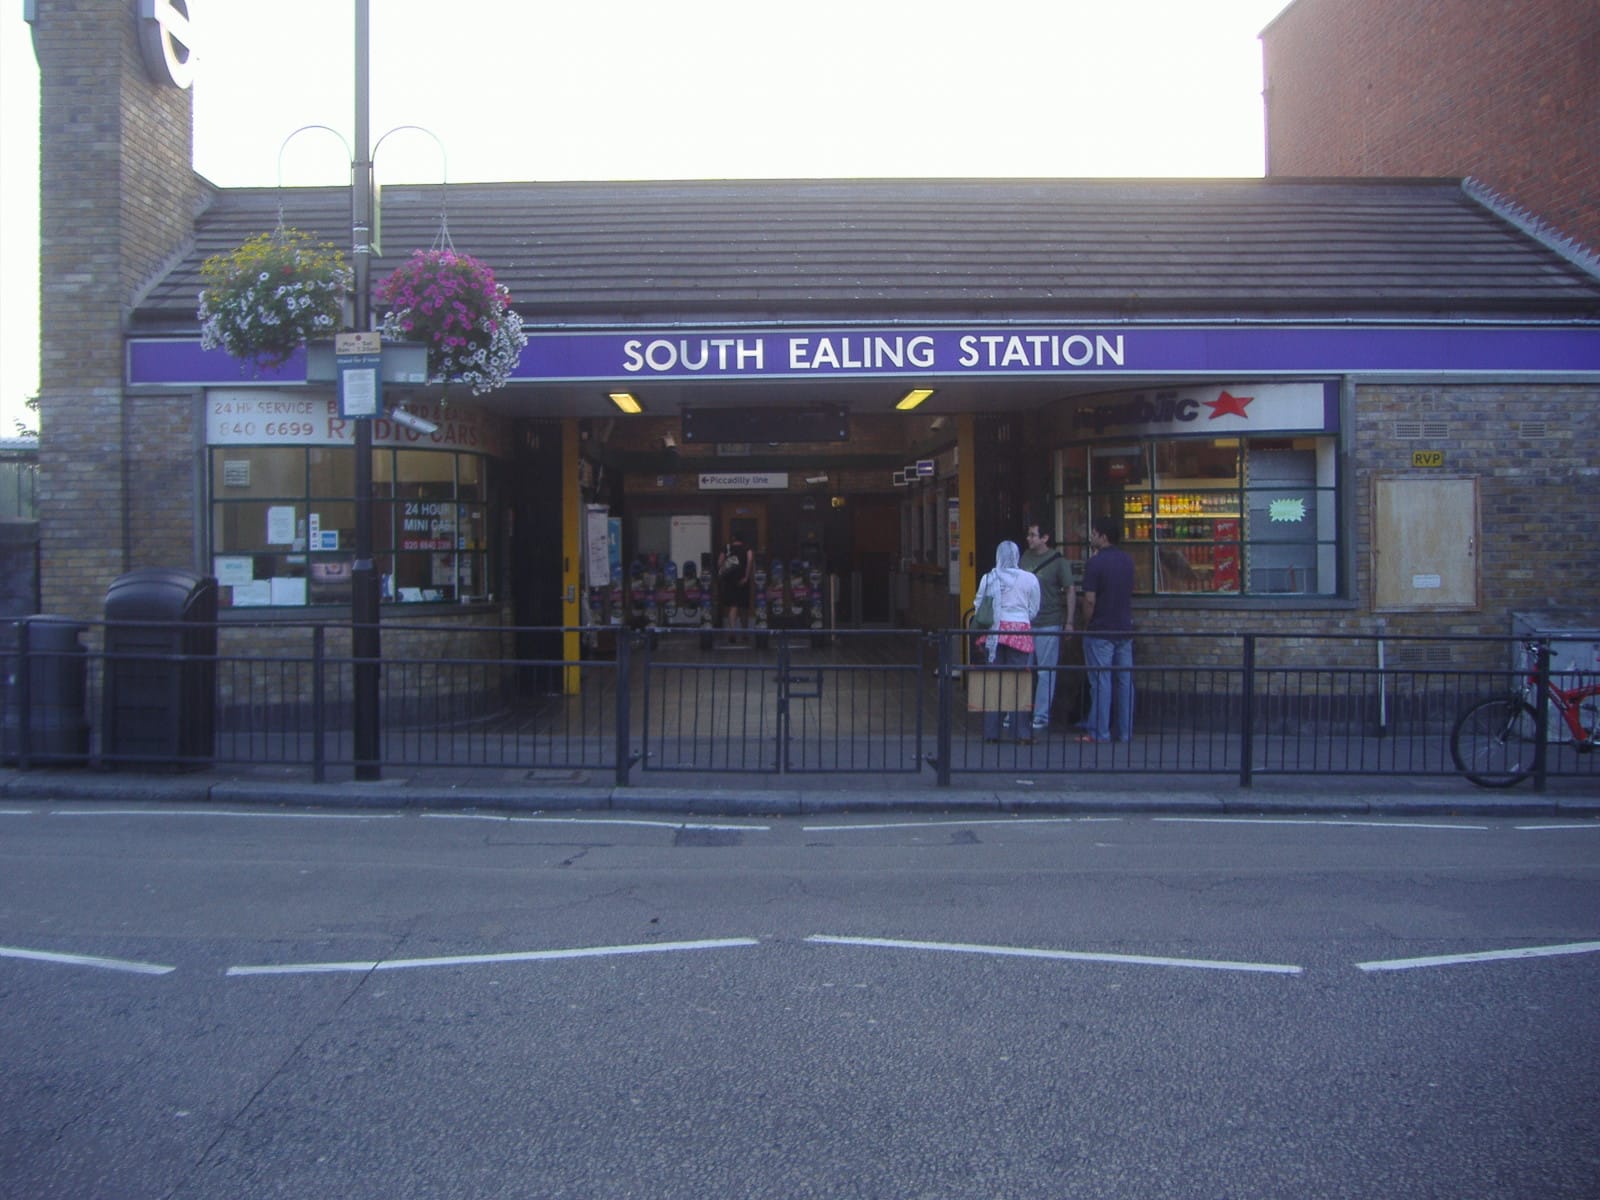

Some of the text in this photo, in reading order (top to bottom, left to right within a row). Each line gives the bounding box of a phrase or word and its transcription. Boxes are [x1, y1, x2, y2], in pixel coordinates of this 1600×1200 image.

[623, 334, 1125, 372] SOUTH EALING STATION
[215, 402, 232, 415] 24
[257, 400, 313, 415] SERVICE
[220, 421, 314, 436] 840 6699
[327, 417, 420, 442] RDIO
[1415, 454, 1441, 464] RVP
[710, 475, 769, 486] Piccadilly line
[405, 503, 449, 515] 24 HOUR
[404, 519, 428, 531] MINI
